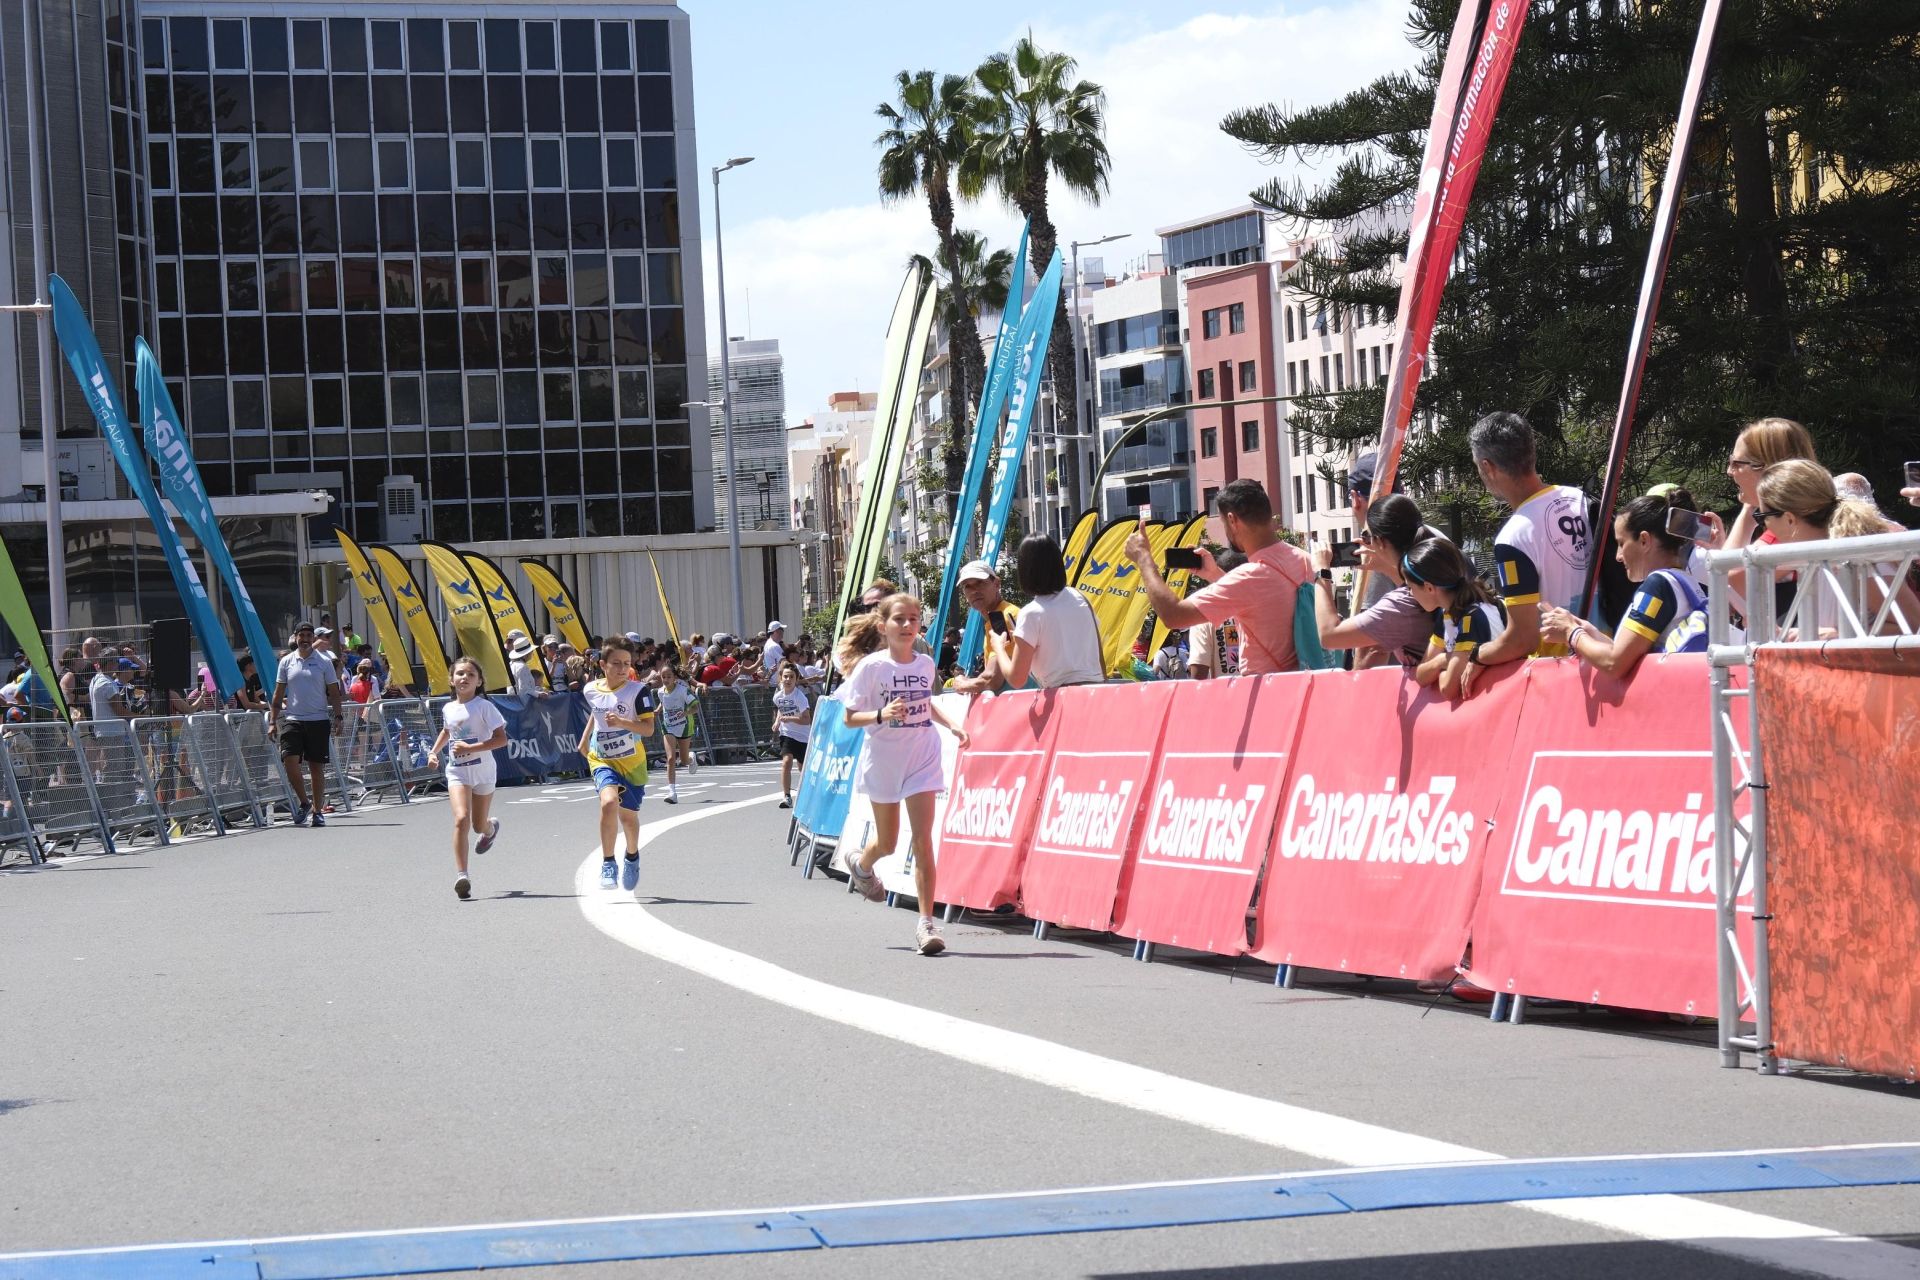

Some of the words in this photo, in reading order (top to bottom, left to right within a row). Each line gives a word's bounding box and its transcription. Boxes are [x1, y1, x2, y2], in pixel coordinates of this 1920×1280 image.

[1495, 2, 1510, 31] de
[999, 323, 1020, 369] RURAL
[893, 675, 929, 688] HPS
[603, 739, 626, 751] 9154
[945, 774, 1027, 839] Canarias7
[1039, 775, 1134, 849] Canarias7
[1147, 780, 1266, 863] Canarias7
